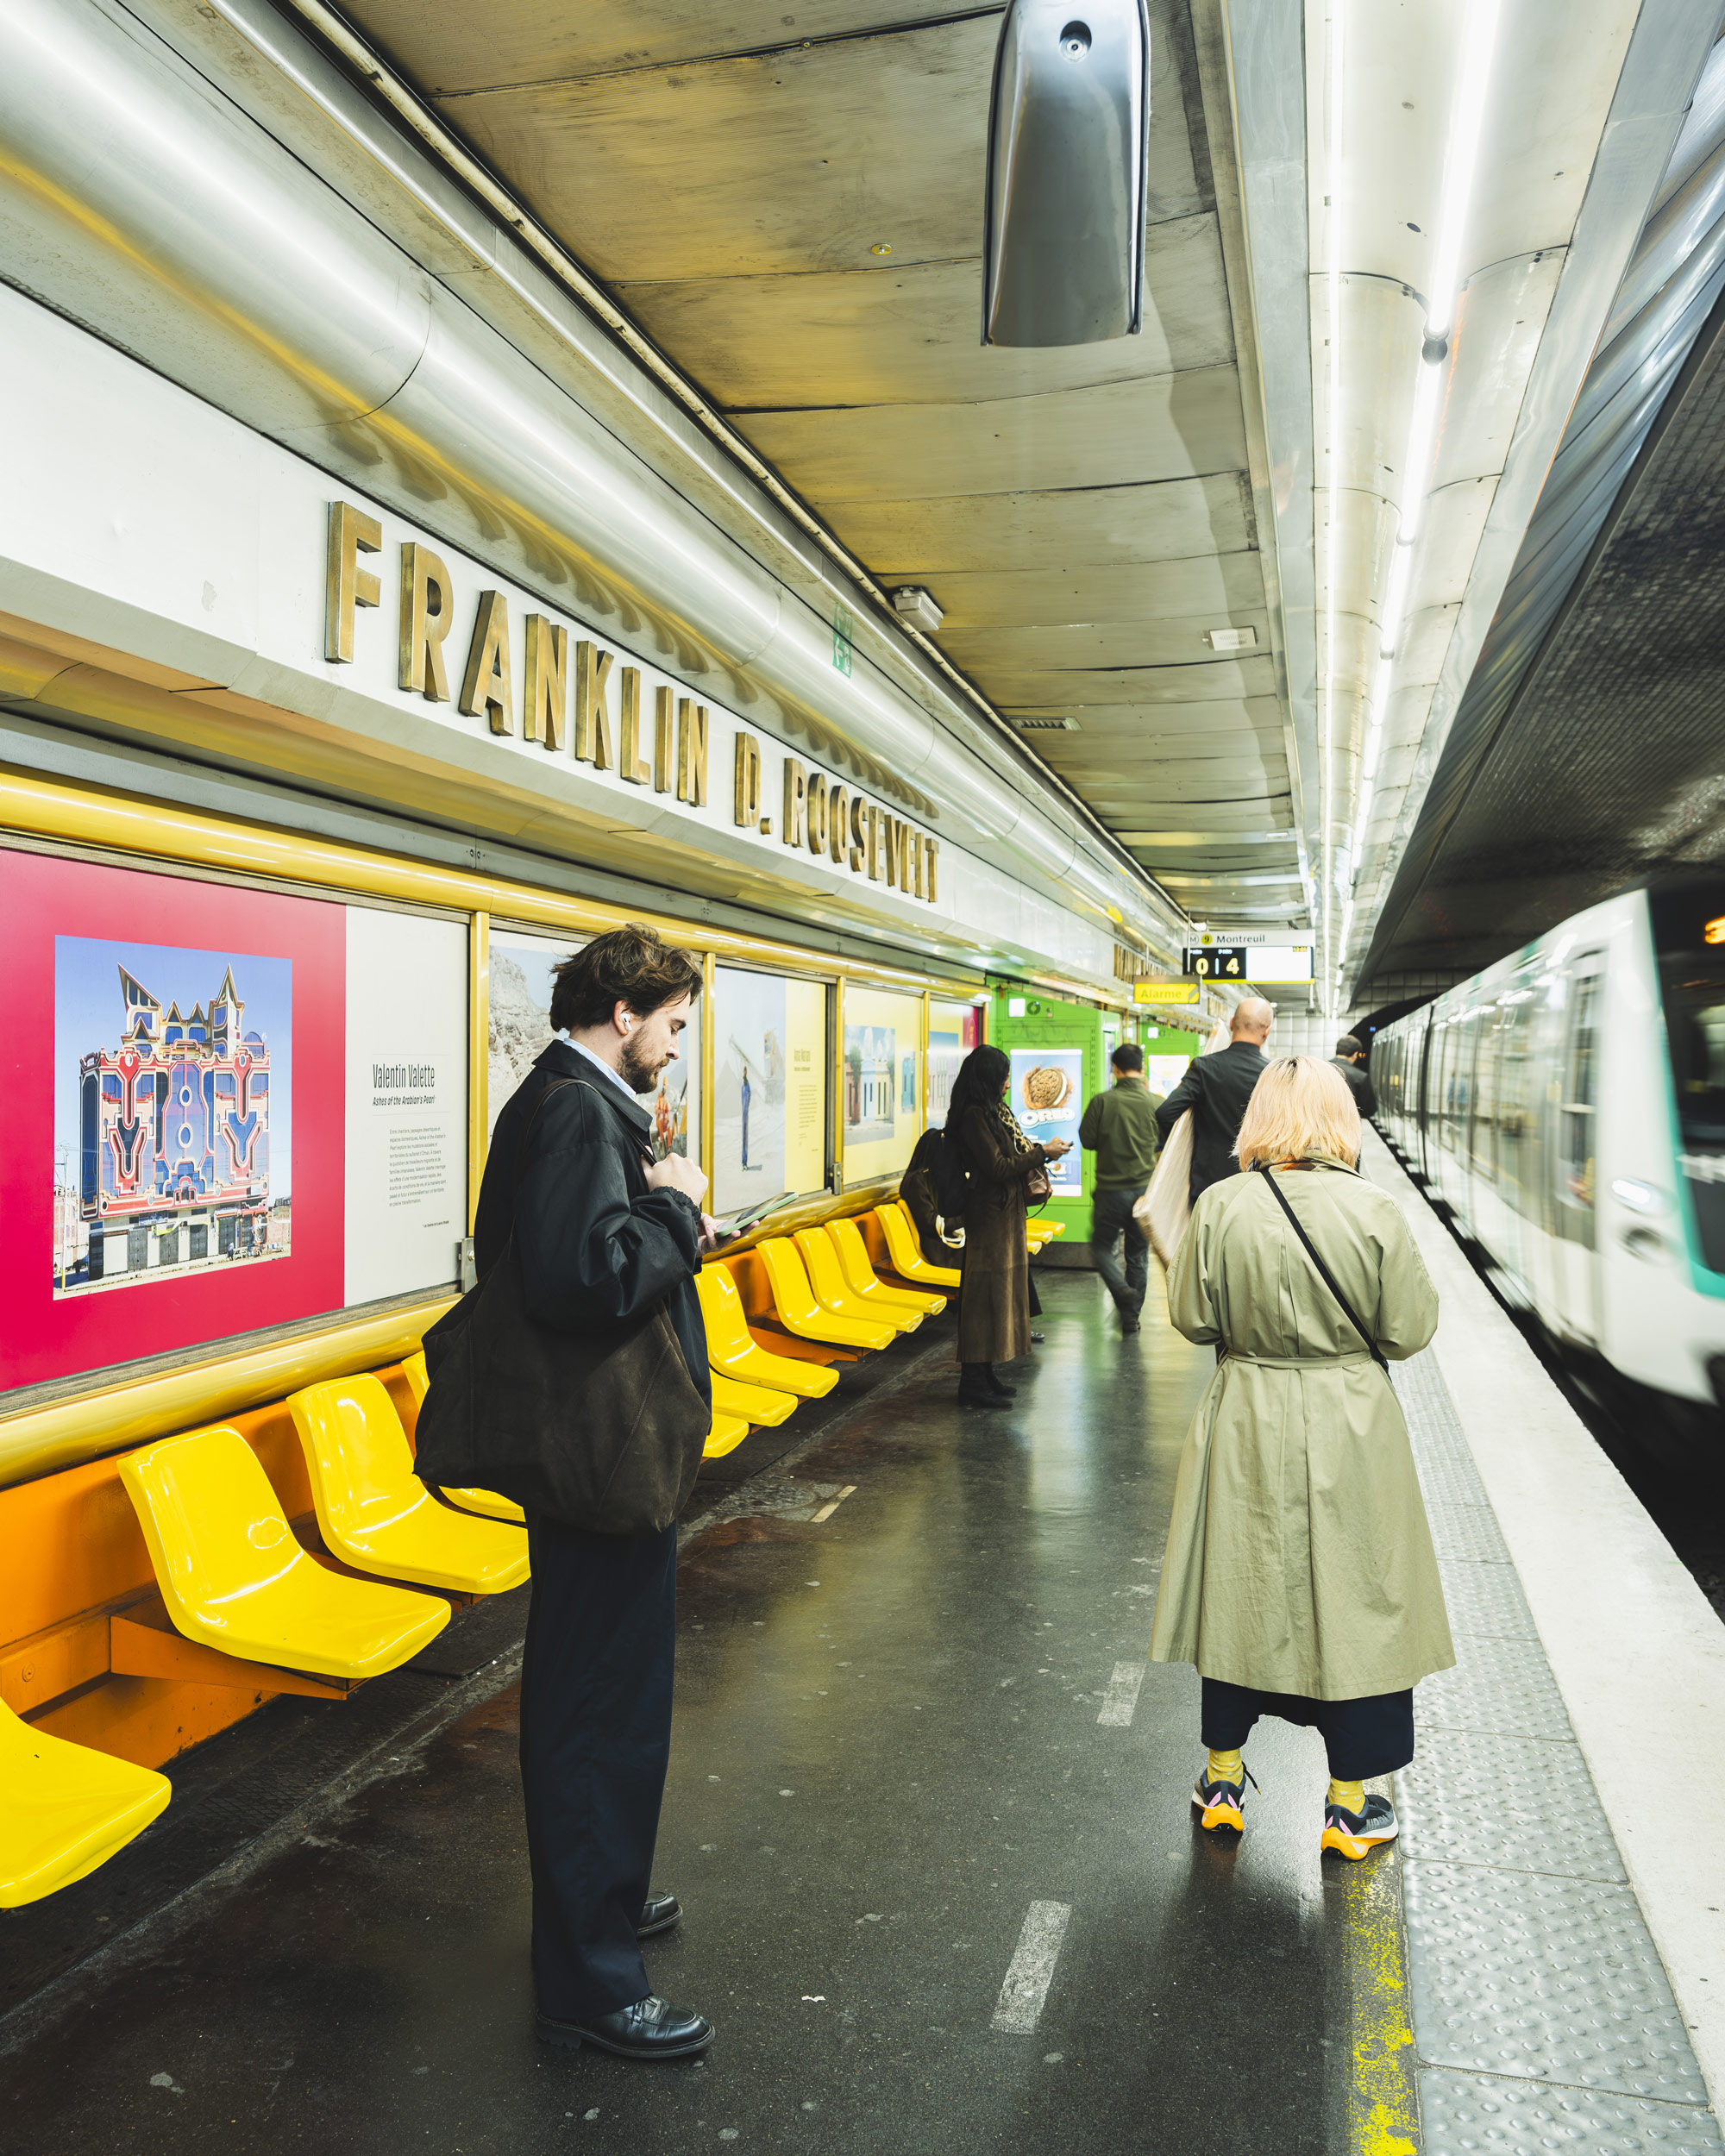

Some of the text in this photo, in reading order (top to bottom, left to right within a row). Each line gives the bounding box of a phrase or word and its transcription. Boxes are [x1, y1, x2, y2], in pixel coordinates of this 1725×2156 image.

[324, 501, 940, 904] FRANKLIN D. ROOSEVELT
[1217, 935, 1265, 943] Montreuil
[1196, 957, 1239, 975] 0 4
[1141, 989, 1182, 999] Alarme
[373, 1063, 435, 1088] Valentin Valette
[373, 1097, 387, 1106] Ashes
[387, 1096, 393, 1106] of
